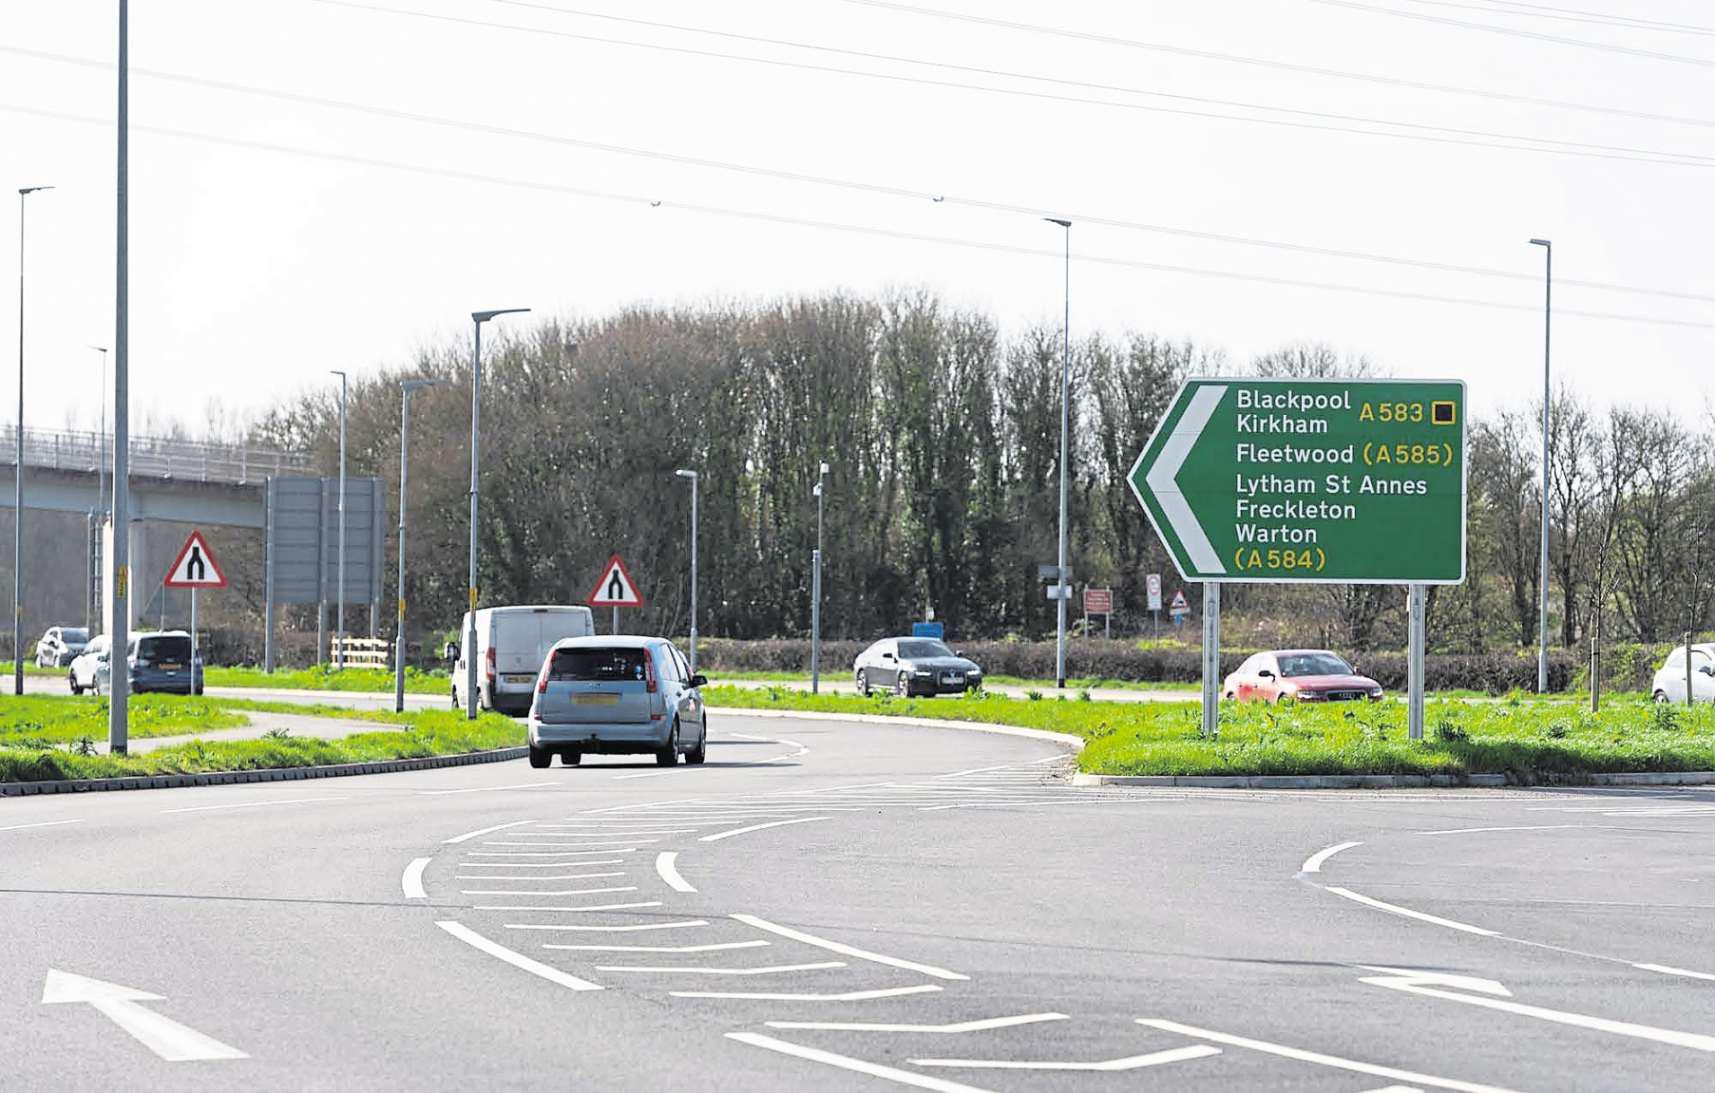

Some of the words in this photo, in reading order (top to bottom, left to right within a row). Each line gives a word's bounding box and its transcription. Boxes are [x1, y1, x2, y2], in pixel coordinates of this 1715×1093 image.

[1237, 390, 1351, 411] Blackpool
[1237, 414, 1329, 433] Kirkham
[1236, 444, 1354, 463] Fleetwood
[1236, 474, 1316, 496] Lytham
[1325, 474, 1351, 494] St
[1360, 475, 1428, 495] Annes
[1236, 500, 1357, 520] Freckleton
[1235, 524, 1318, 543] Warton
